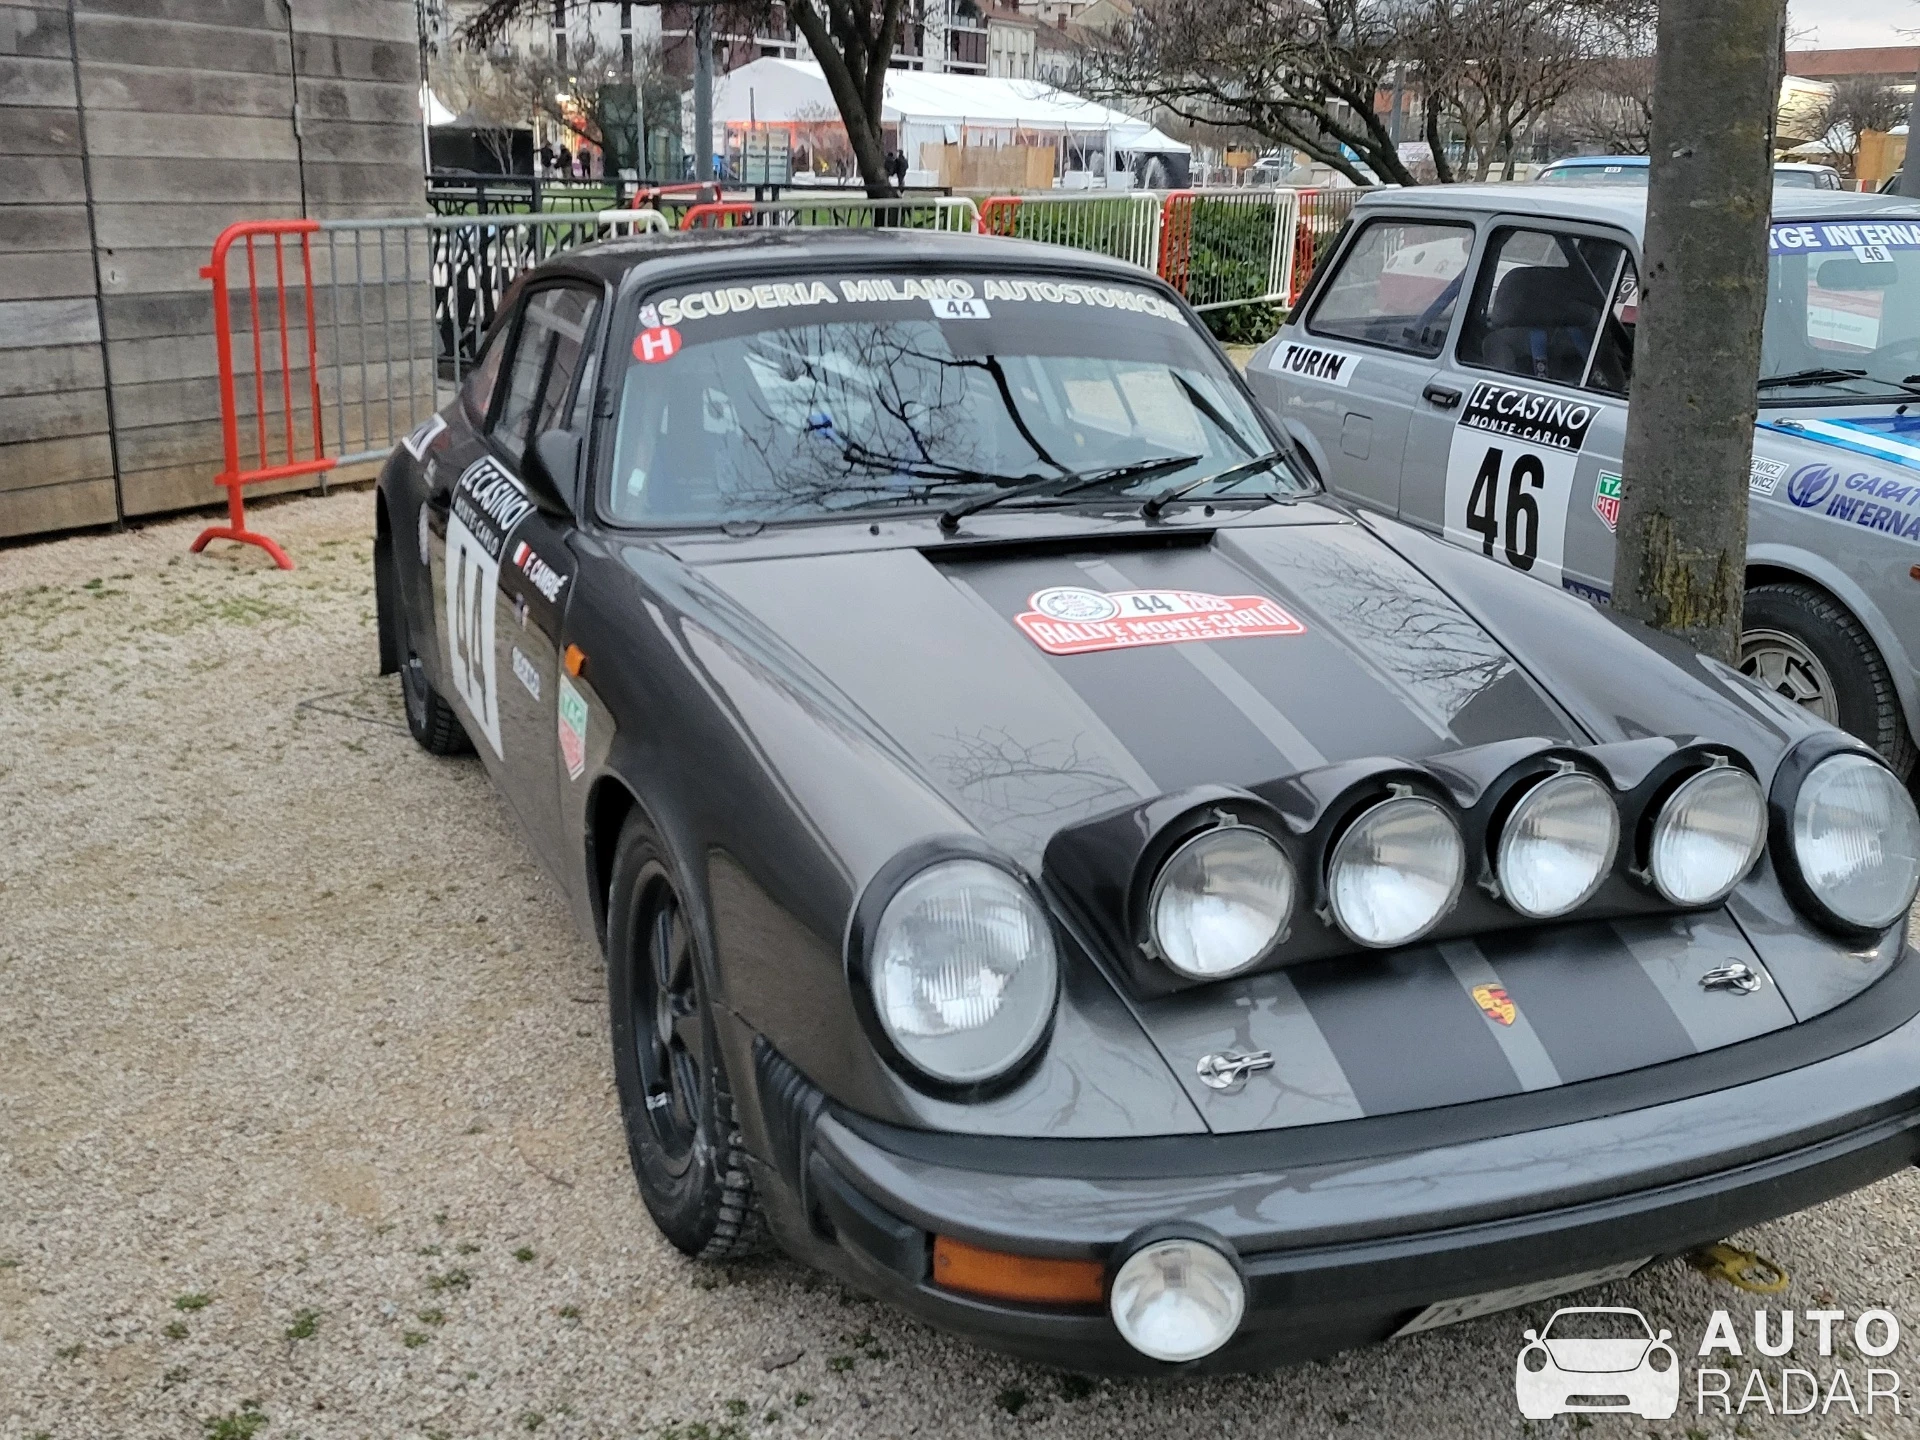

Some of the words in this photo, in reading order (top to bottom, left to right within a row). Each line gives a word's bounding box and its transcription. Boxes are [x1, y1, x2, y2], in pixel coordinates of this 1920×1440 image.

[1863, 246, 1885, 261] 46
[658, 281, 839, 326] SCUDERIA
[839, 278, 975, 303] MILANO
[983, 279, 1189, 327] AUTOSTORICHE
[946, 301, 976, 317] 44
[641, 328, 674, 361] H
[1282, 344, 1348, 381] TURIN
[1465, 446, 1545, 572] 46
[1132, 595, 1175, 613] 44
[456, 545, 490, 726] 44
[1030, 621, 1129, 645] RALLYE
[1126, 603, 1291, 636] MONTE-CARLO
[1114, 628, 1245, 645] HISTORIQUE
